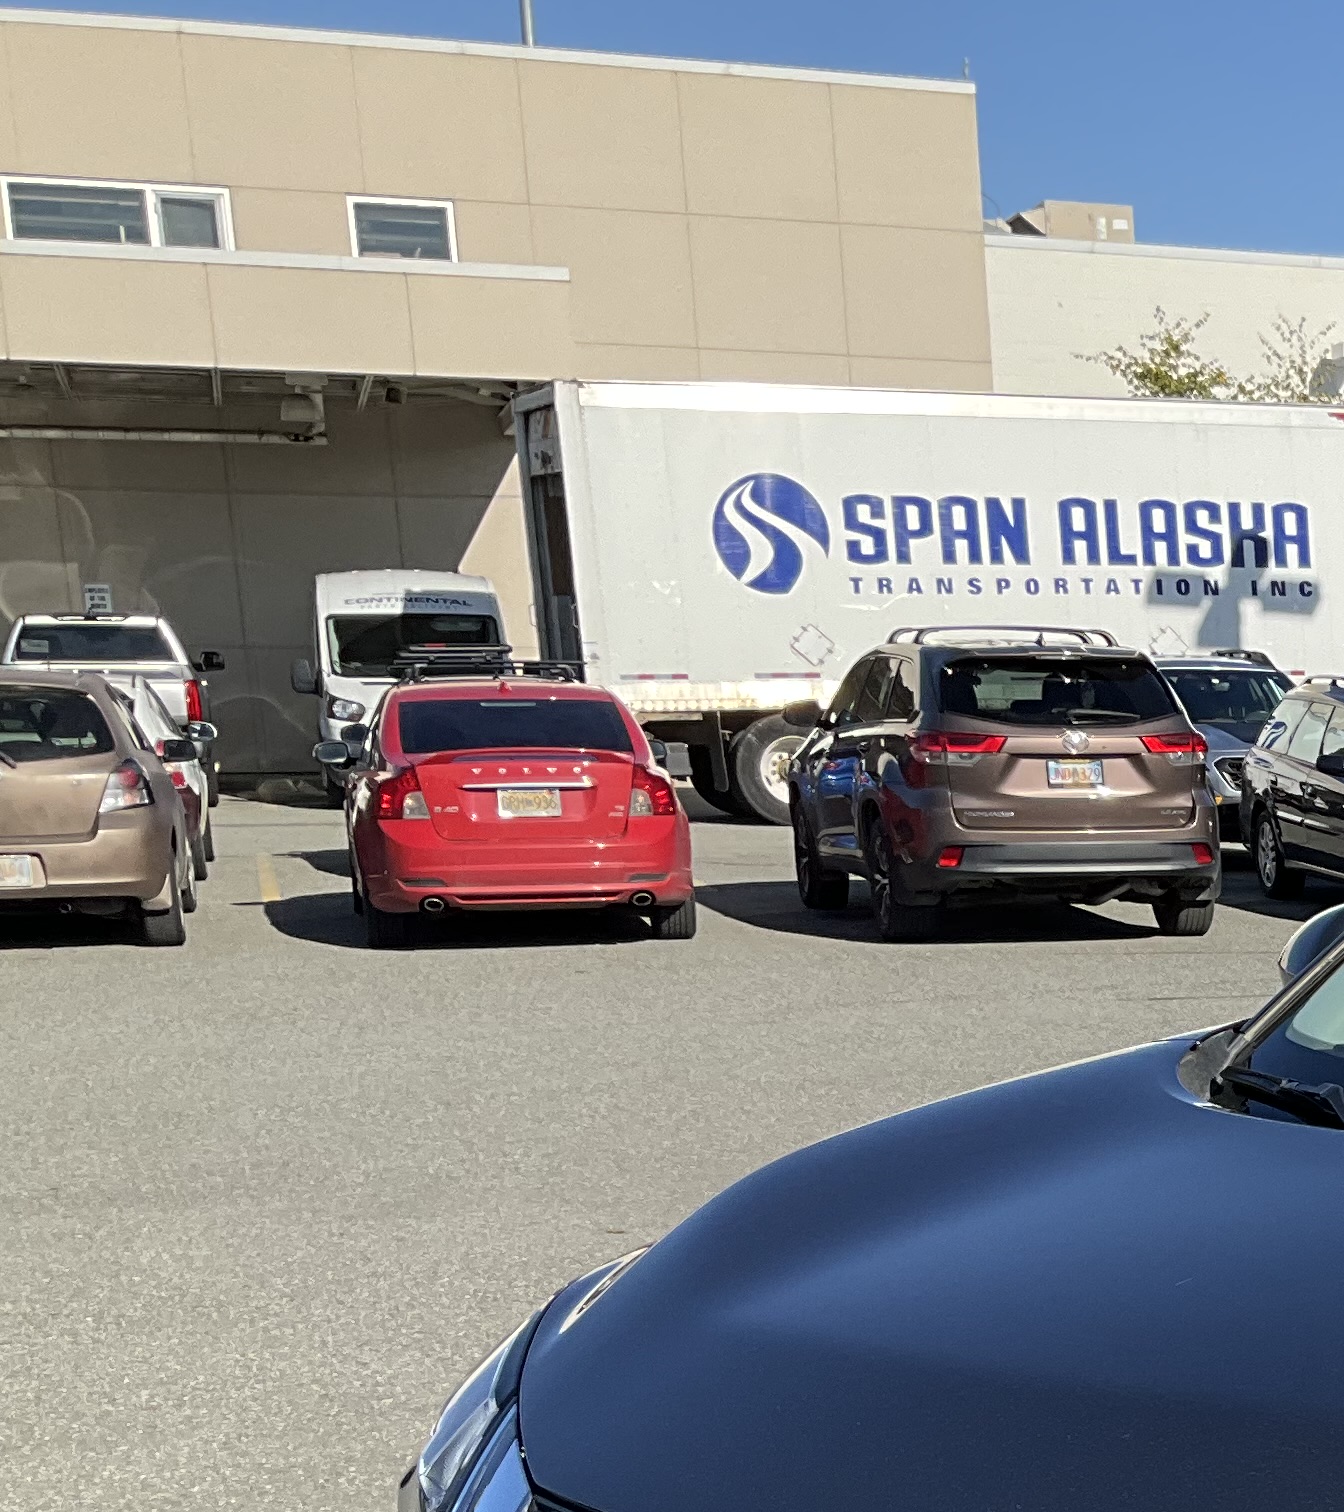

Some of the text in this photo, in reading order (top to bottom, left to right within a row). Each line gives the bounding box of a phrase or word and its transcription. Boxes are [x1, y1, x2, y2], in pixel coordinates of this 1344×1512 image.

[841, 493, 1312, 569] SPAN ALASKA
[849, 576, 1314, 598] TRANSPORTATION INC
[343, 596, 474, 608] CONTINENTAL
[471, 767, 583, 775] VOLVO
